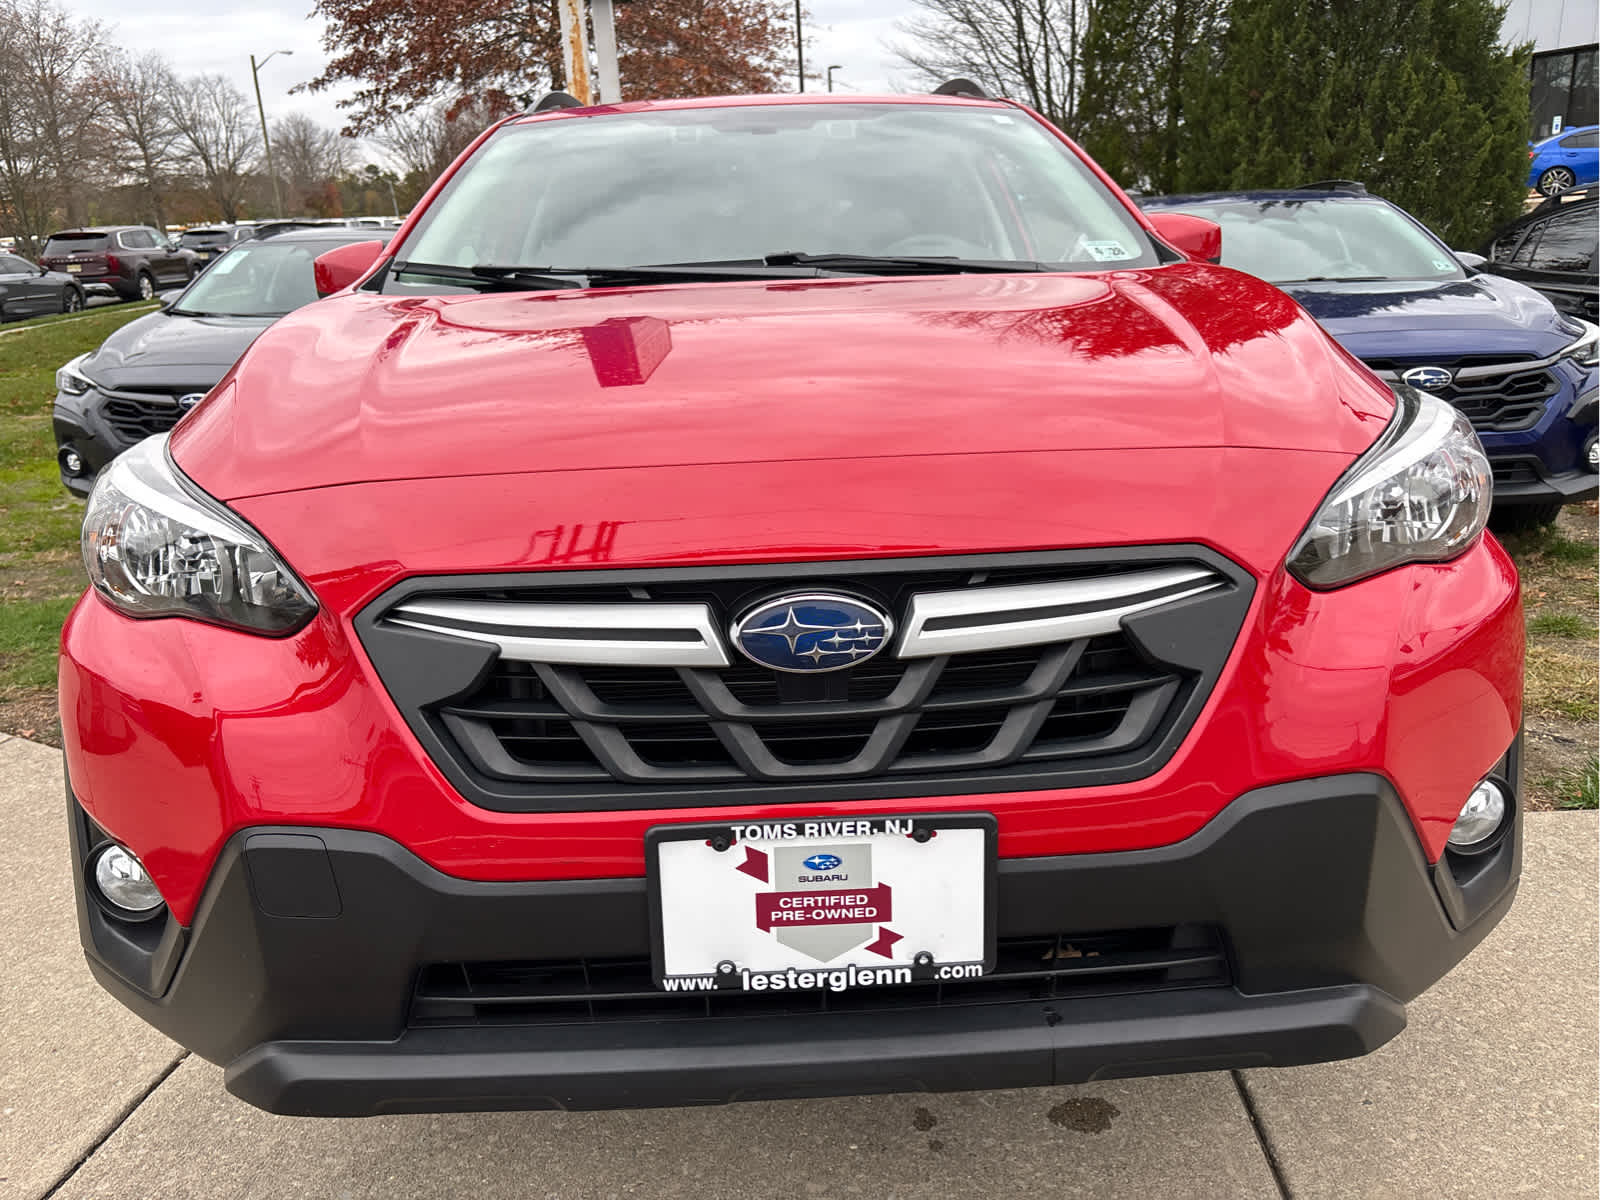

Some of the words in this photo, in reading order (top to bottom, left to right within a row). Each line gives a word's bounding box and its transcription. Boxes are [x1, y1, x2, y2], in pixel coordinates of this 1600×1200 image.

[732, 824, 796, 841] TOMS
[804, 820, 877, 838] RIVER,
[885, 820, 914, 834] NJ
[798, 874, 848, 883] SUBARU
[779, 894, 868, 909] CERTIFIED
[771, 907, 878, 921] PRE-OWNED
[663, 976, 719, 991] www.
[742, 967, 912, 992] lesterglenn
[934, 964, 983, 980] .com
